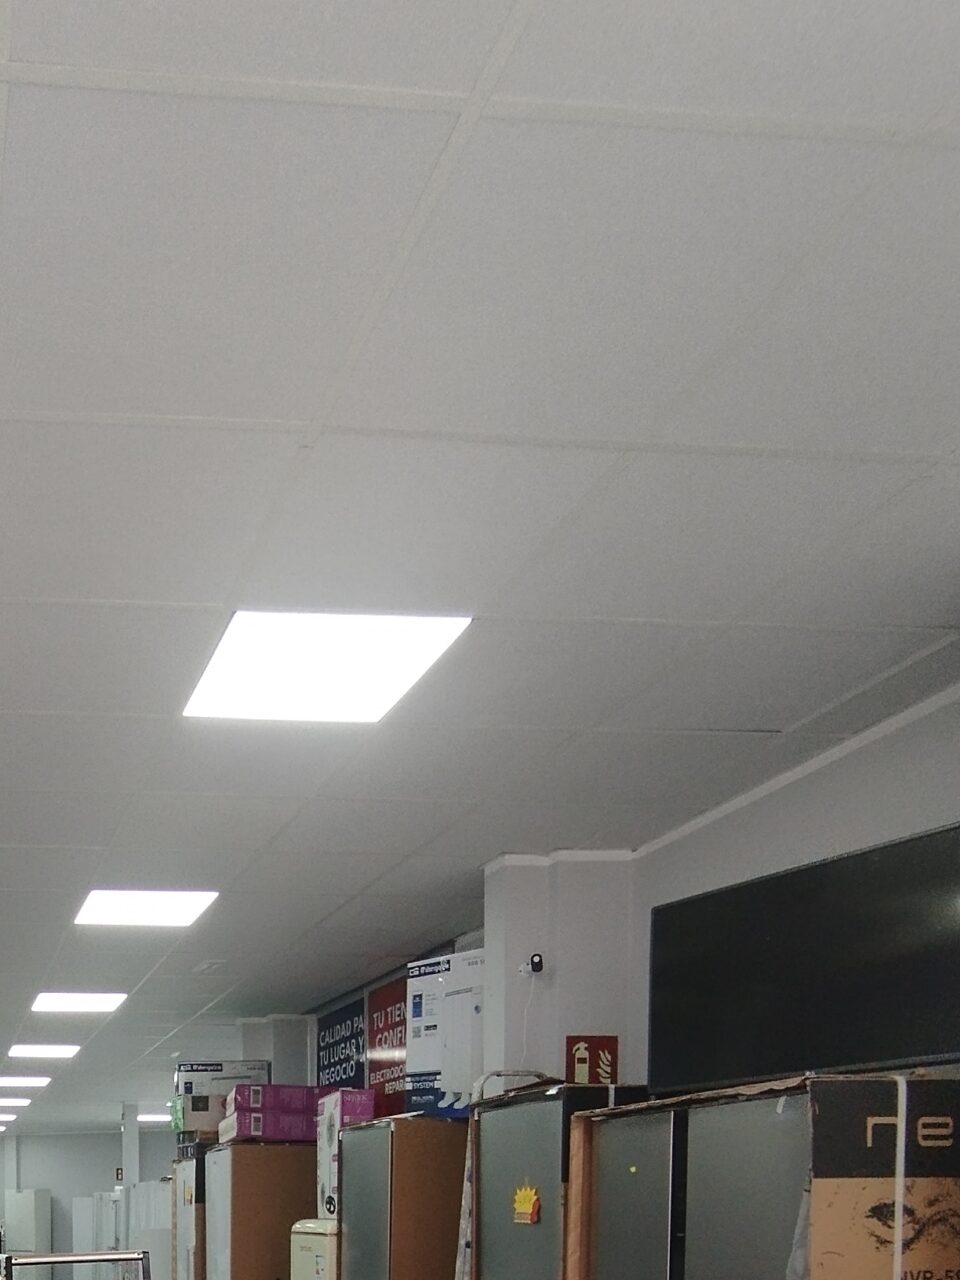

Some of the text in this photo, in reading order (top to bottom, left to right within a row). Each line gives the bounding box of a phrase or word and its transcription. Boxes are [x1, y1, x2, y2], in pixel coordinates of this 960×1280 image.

[320, 1015, 364, 1047] CALIDAD PA
[373, 1010, 385, 1031] TU
[320, 1048, 329, 1066] TU
[330, 1039, 356, 1062] LUGAR
[320, 1060, 356, 1086] NEGOCIO
